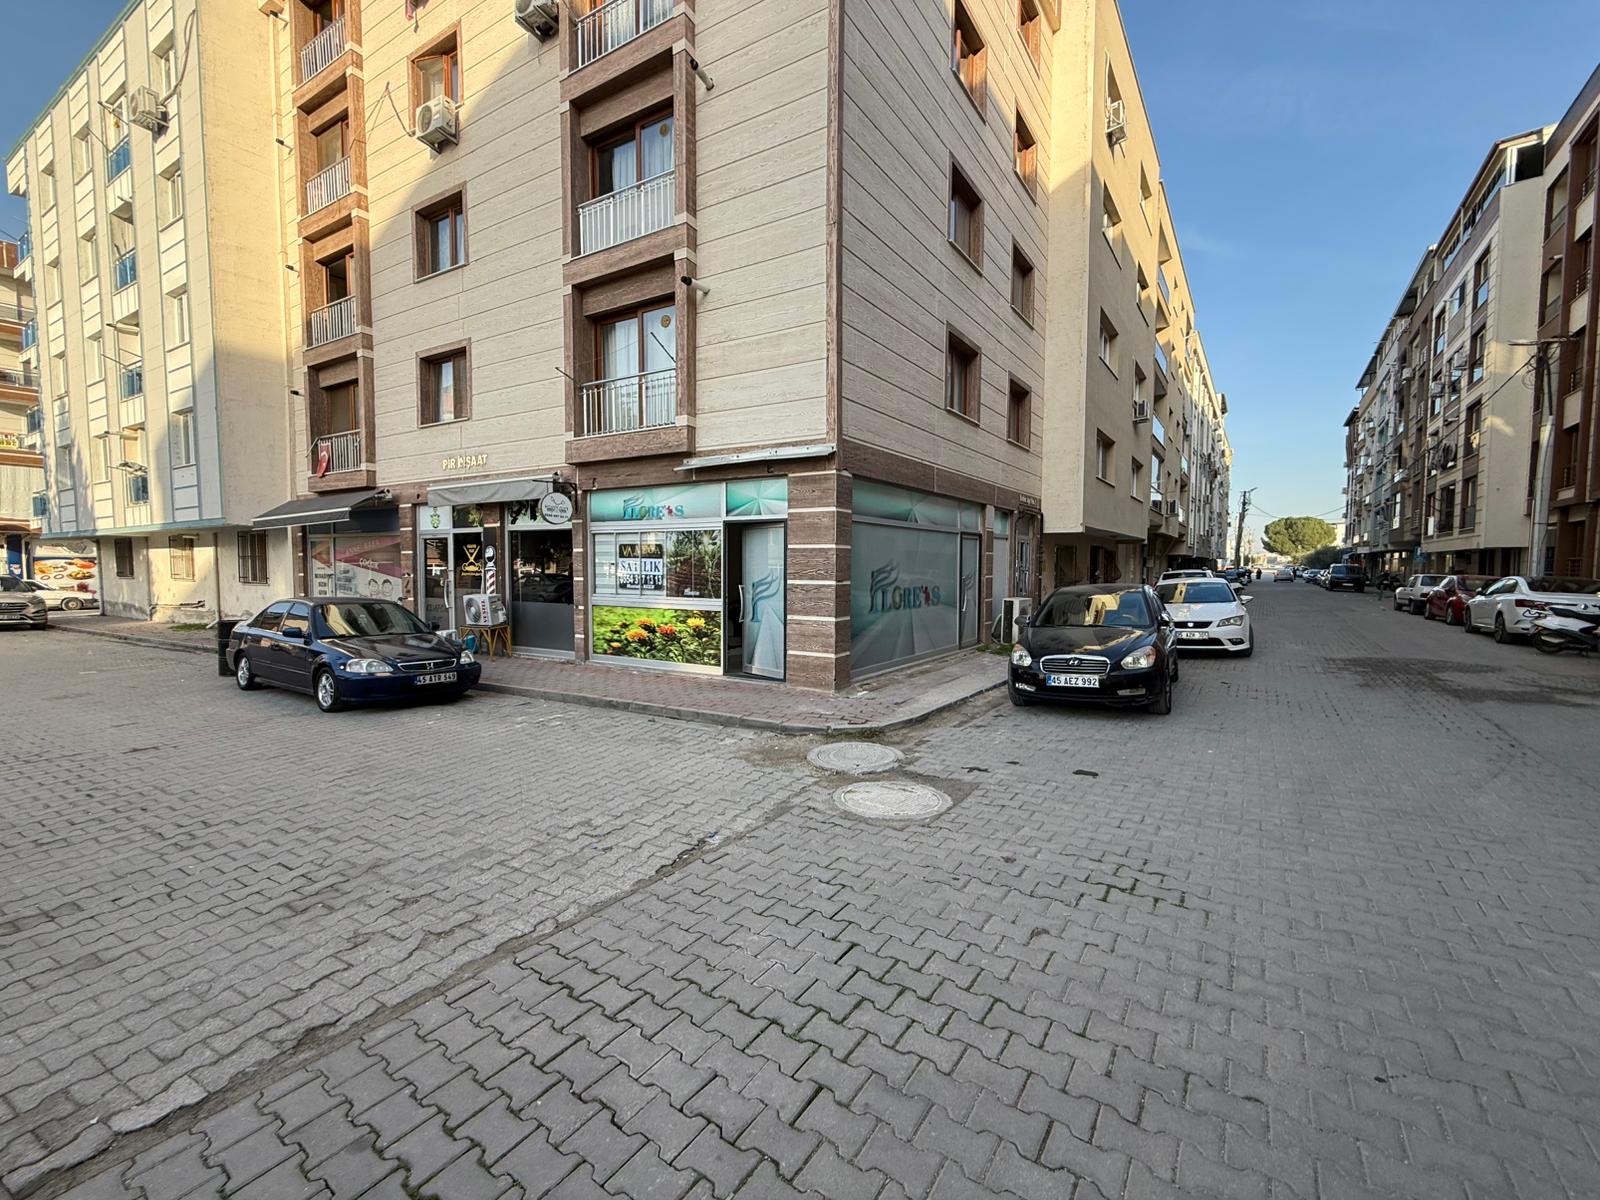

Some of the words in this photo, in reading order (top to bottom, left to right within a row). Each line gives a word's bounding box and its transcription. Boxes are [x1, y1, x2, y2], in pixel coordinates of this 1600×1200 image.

[620, 560, 661, 572] SATLIK
[1051, 676, 1062, 685] 45
[1064, 676, 1079, 686] AEZ
[1081, 677, 1097, 687] 992
